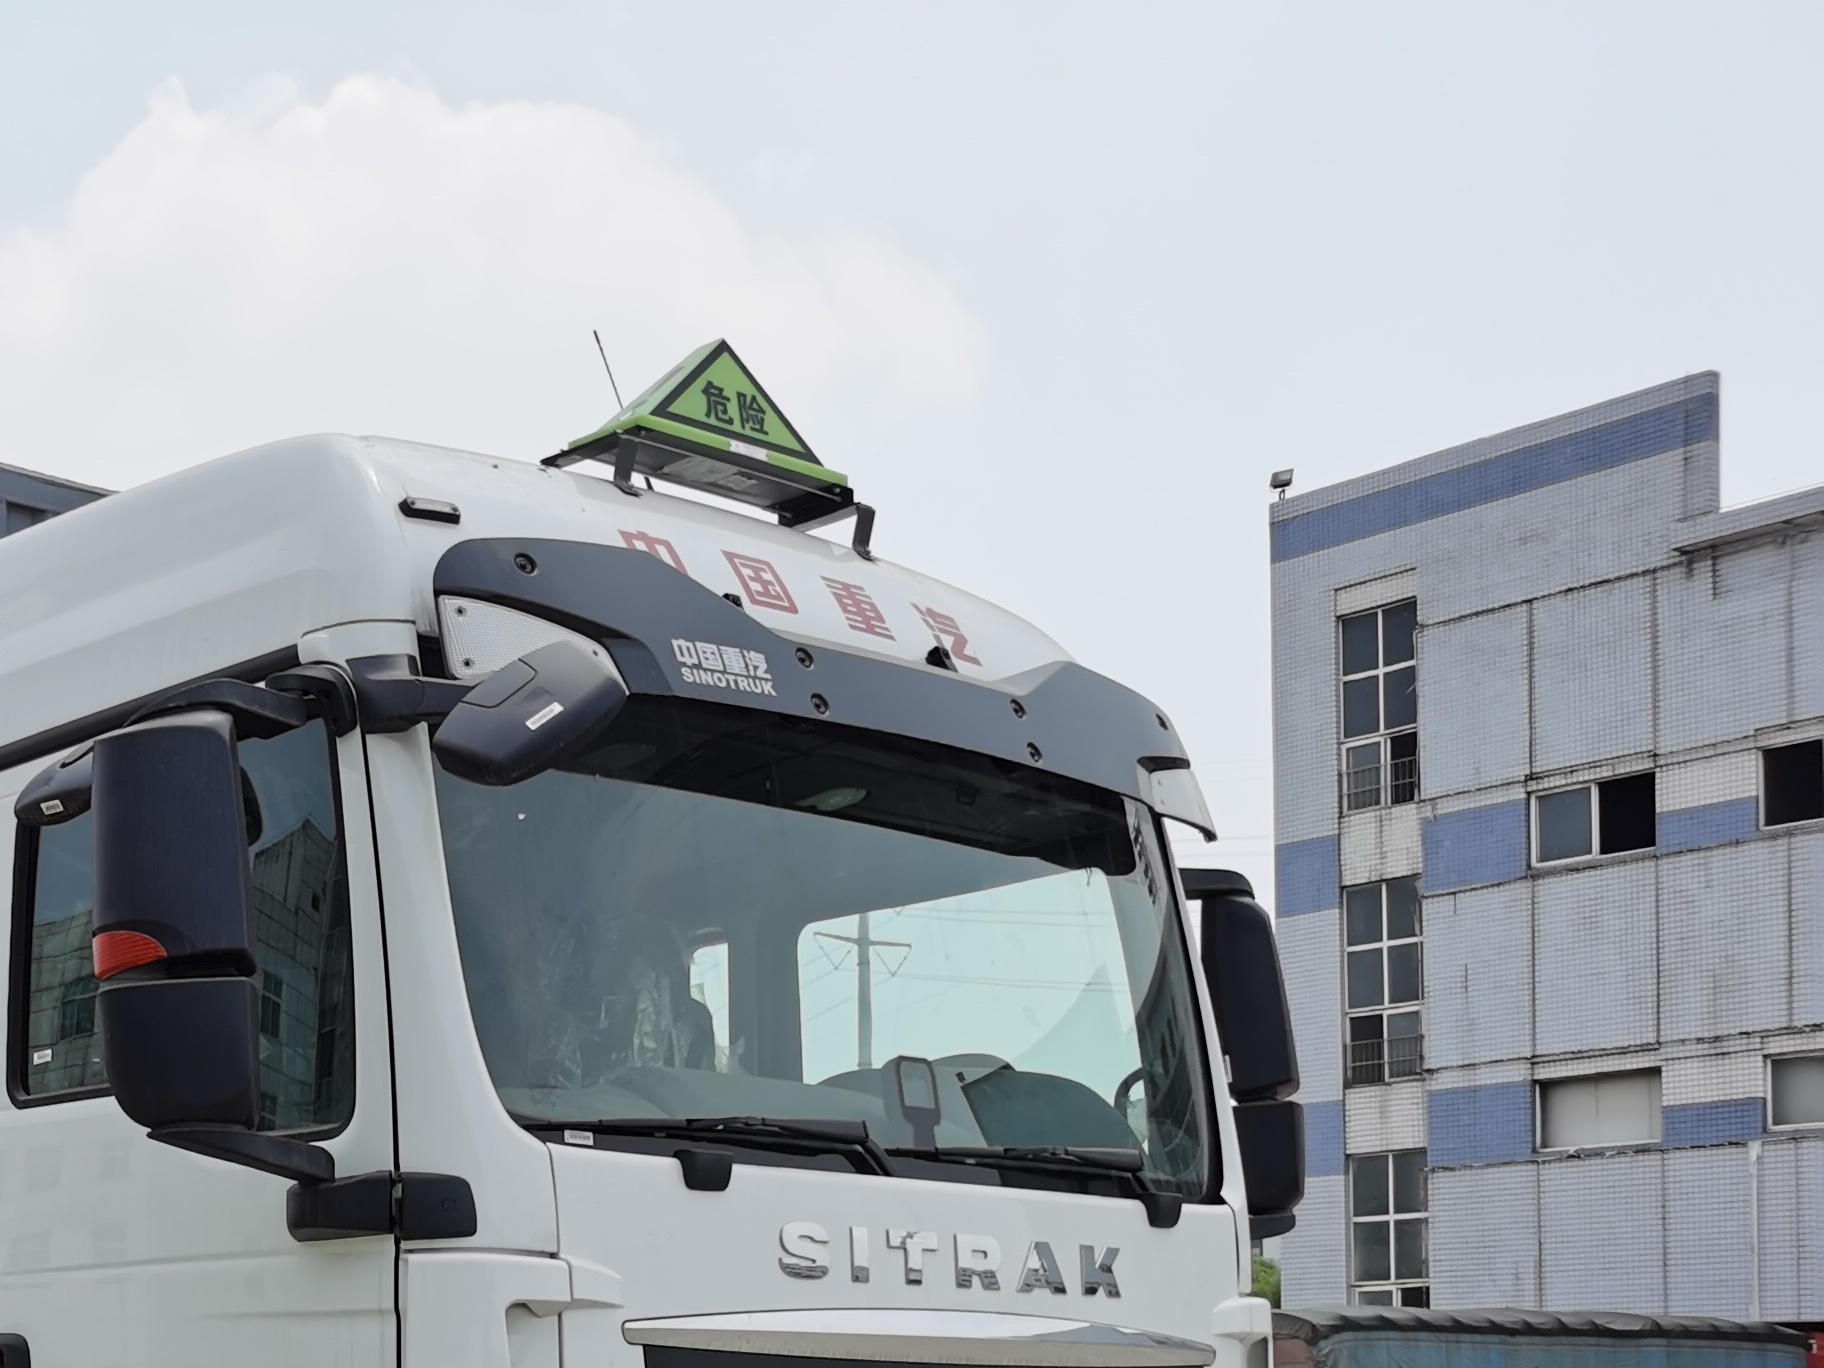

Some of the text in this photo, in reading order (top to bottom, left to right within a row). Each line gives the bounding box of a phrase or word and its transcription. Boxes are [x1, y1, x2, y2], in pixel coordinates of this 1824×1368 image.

[701, 380, 769, 436] 危险
[671, 638, 773, 679] 中国重汽
[680, 667, 778, 697] SINOTRUK
[778, 1221, 1122, 1299] SITRAK
